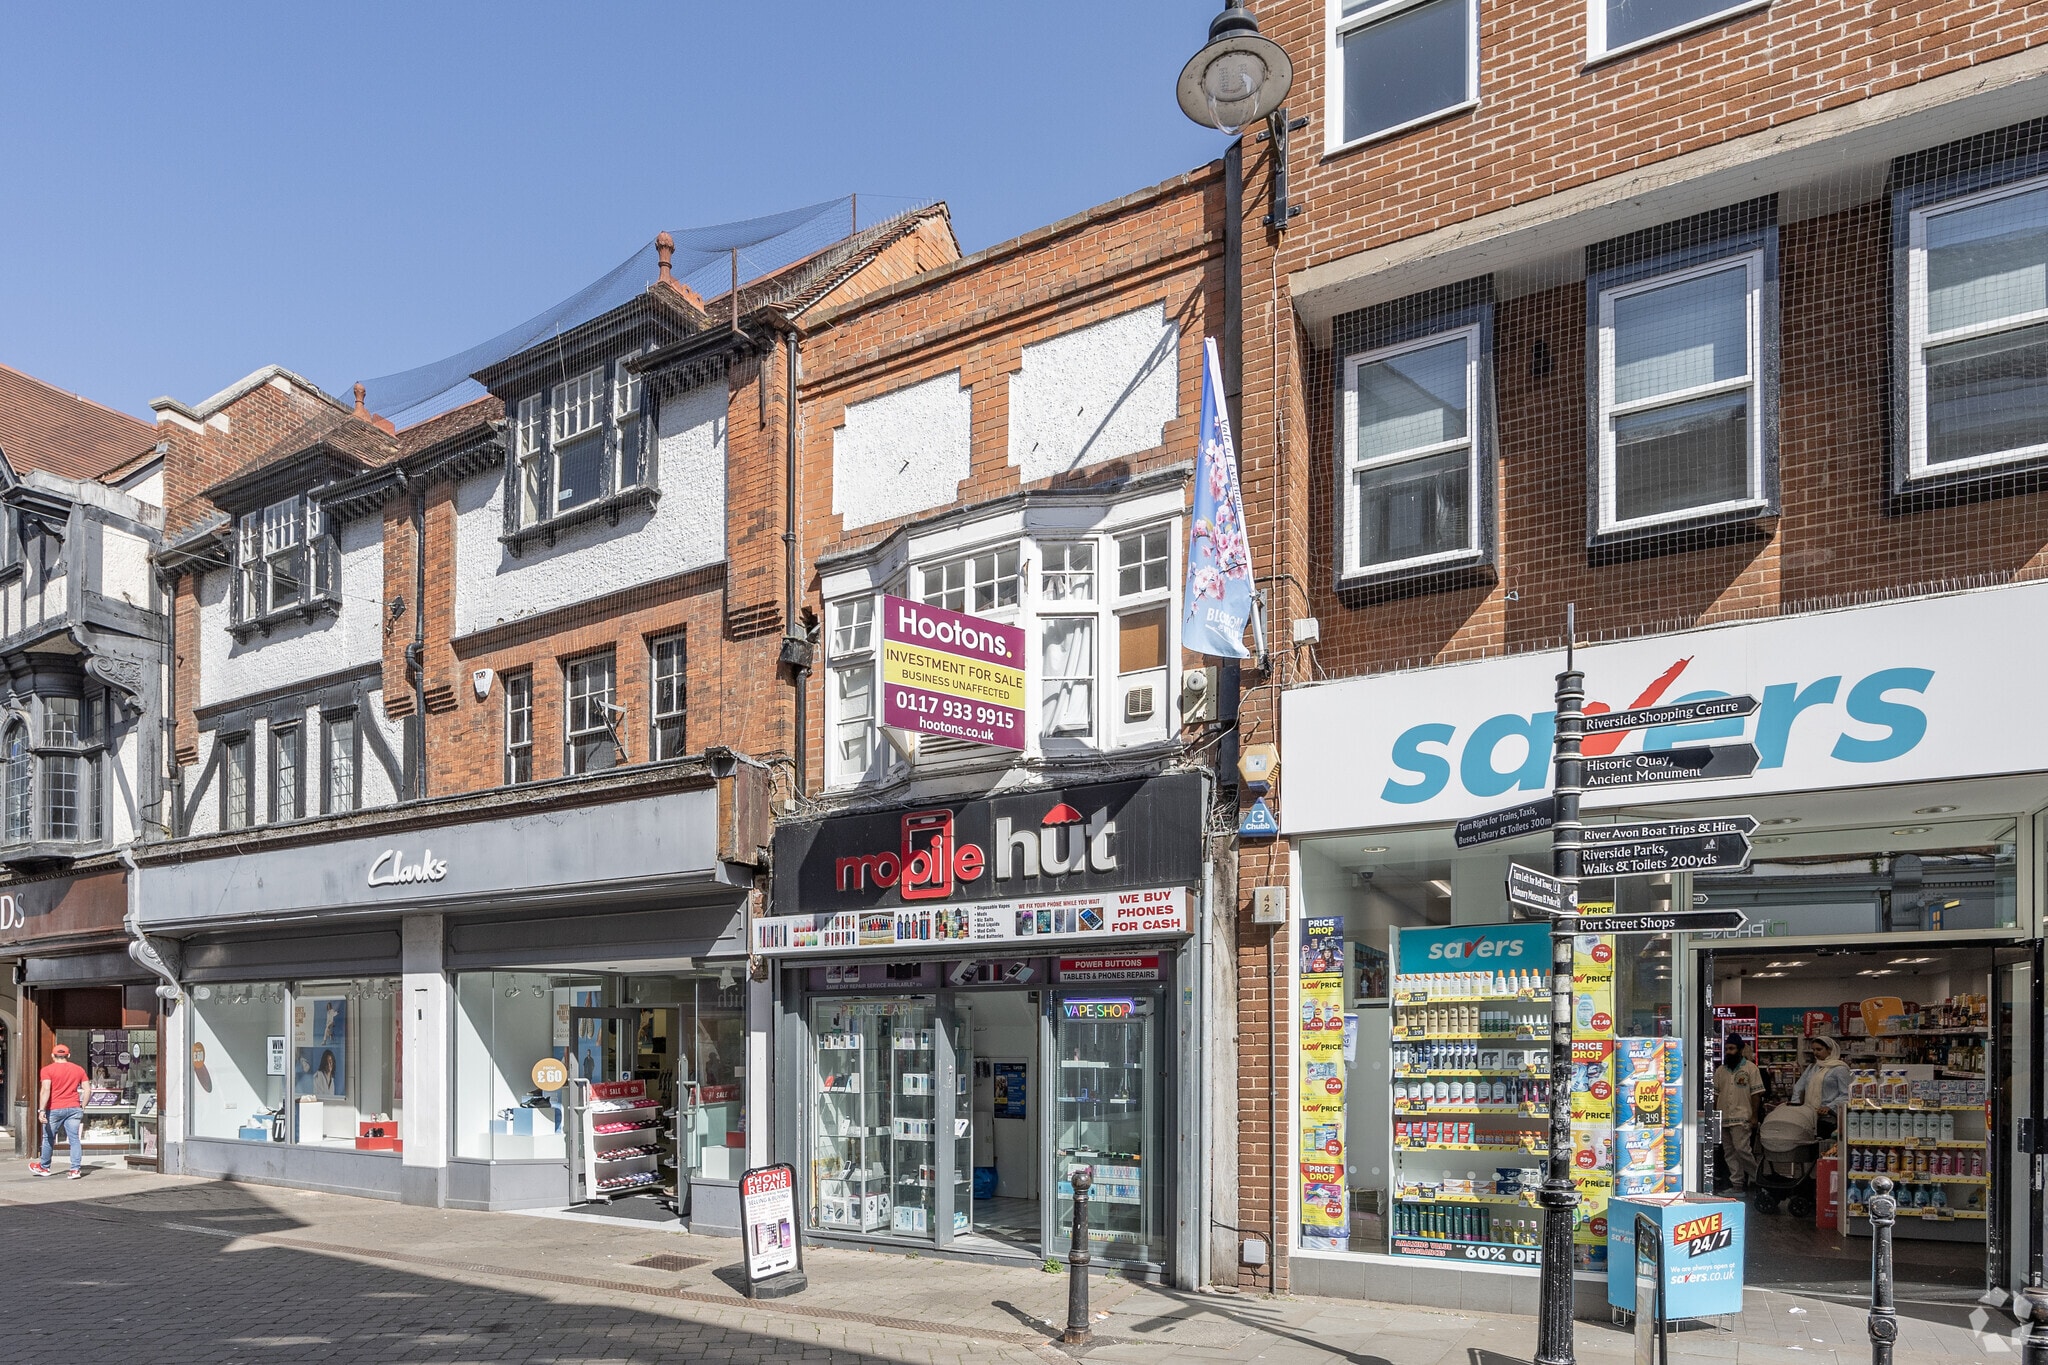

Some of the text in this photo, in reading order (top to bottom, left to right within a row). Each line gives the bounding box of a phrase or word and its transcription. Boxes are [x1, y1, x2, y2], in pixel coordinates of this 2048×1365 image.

[1221, 419, 1231, 443] Vale
[899, 606, 1012, 659] Hootons.
[886, 649, 1023, 688] INVESTMENT FOR SALE
[902, 669, 1010, 700] BUSINESS UNAFFECTED
[896, 692, 1014, 729] 0117 933 9915
[1586, 701, 1738, 730] Riverside Shopping Centre
[919, 716, 994, 741] hootons.co.uk
[1380, 655, 1935, 804] savers
[1587, 755, 1674, 771] Historic Quay,
[1587, 767, 1702, 786] Ancient Monument
[1460, 823, 1472, 832] Turn
[1472, 819, 1488, 829] Right
[1489, 816, 1498, 824] for
[1478, 829, 1499, 840] Library
[1508, 822, 1529, 834] Toilets
[1531, 817, 1552, 829] 300m
[1584, 822, 1736, 840] River Avon Boat Trips & Hire
[996, 803, 1118, 882] hut
[836, 809, 985, 900] mobile
[1583, 843, 1669, 861] Riverside Parks,
[368, 849, 447, 887] Clarks
[1583, 854, 1717, 875] Walks & Toilets 200yds
[1119, 891, 1171, 904] WE BUY
[1117, 905, 1174, 918] PHONES
[1587, 907, 1612, 915] PRICE
[1111, 918, 1180, 932] FOR CASH
[1308, 919, 1334, 927] PRICE
[1580, 917, 1675, 930] Port Street Shops
[1309, 927, 1334, 936] DROP
[1428, 935, 1524, 959] savers
[1075, 959, 1142, 969] POWER BUTTONS
[1127, 971, 1155, 979] REPAIRS
[1302, 981, 1342, 990] LOW PRICE
[1064, 1004, 1131, 1018] VAPE SHOP
[272, 1039, 284, 1050] WIN
[1302, 1042, 1321, 1051] LOW
[1572, 1042, 1603, 1050] PRICE
[1572, 1051, 1603, 1060] DROP
[1640, 1082, 1660, 1095] LOW
[1639, 1094, 1659, 1104] PRICE
[1302, 1104, 1322, 1112] LOW
[1585, 1112, 1611, 1120] PRICE
[1309, 1165, 1335, 1173] PRICE
[747, 1171, 787, 1187] PHONE
[1310, 1174, 1335, 1183] DROP
[1585, 1180, 1611, 1188] PRICE
[748, 1179, 787, 1195] REPAIR
[749, 1197, 768, 1207] SELLING
[1676, 1214, 1720, 1241] SAVE
[1395, 1239, 1452, 1250] AMAZING VALUE
[1691, 1228, 1730, 1256] 24/7
[1401, 1247, 1446, 1257] FRAGRANCES
[1465, 1246, 1506, 1261] 60%
[1692, 1264, 1713, 1272] always
[1714, 1263, 1728, 1271] open
[1671, 1269, 1735, 1285] savers.co.uk
